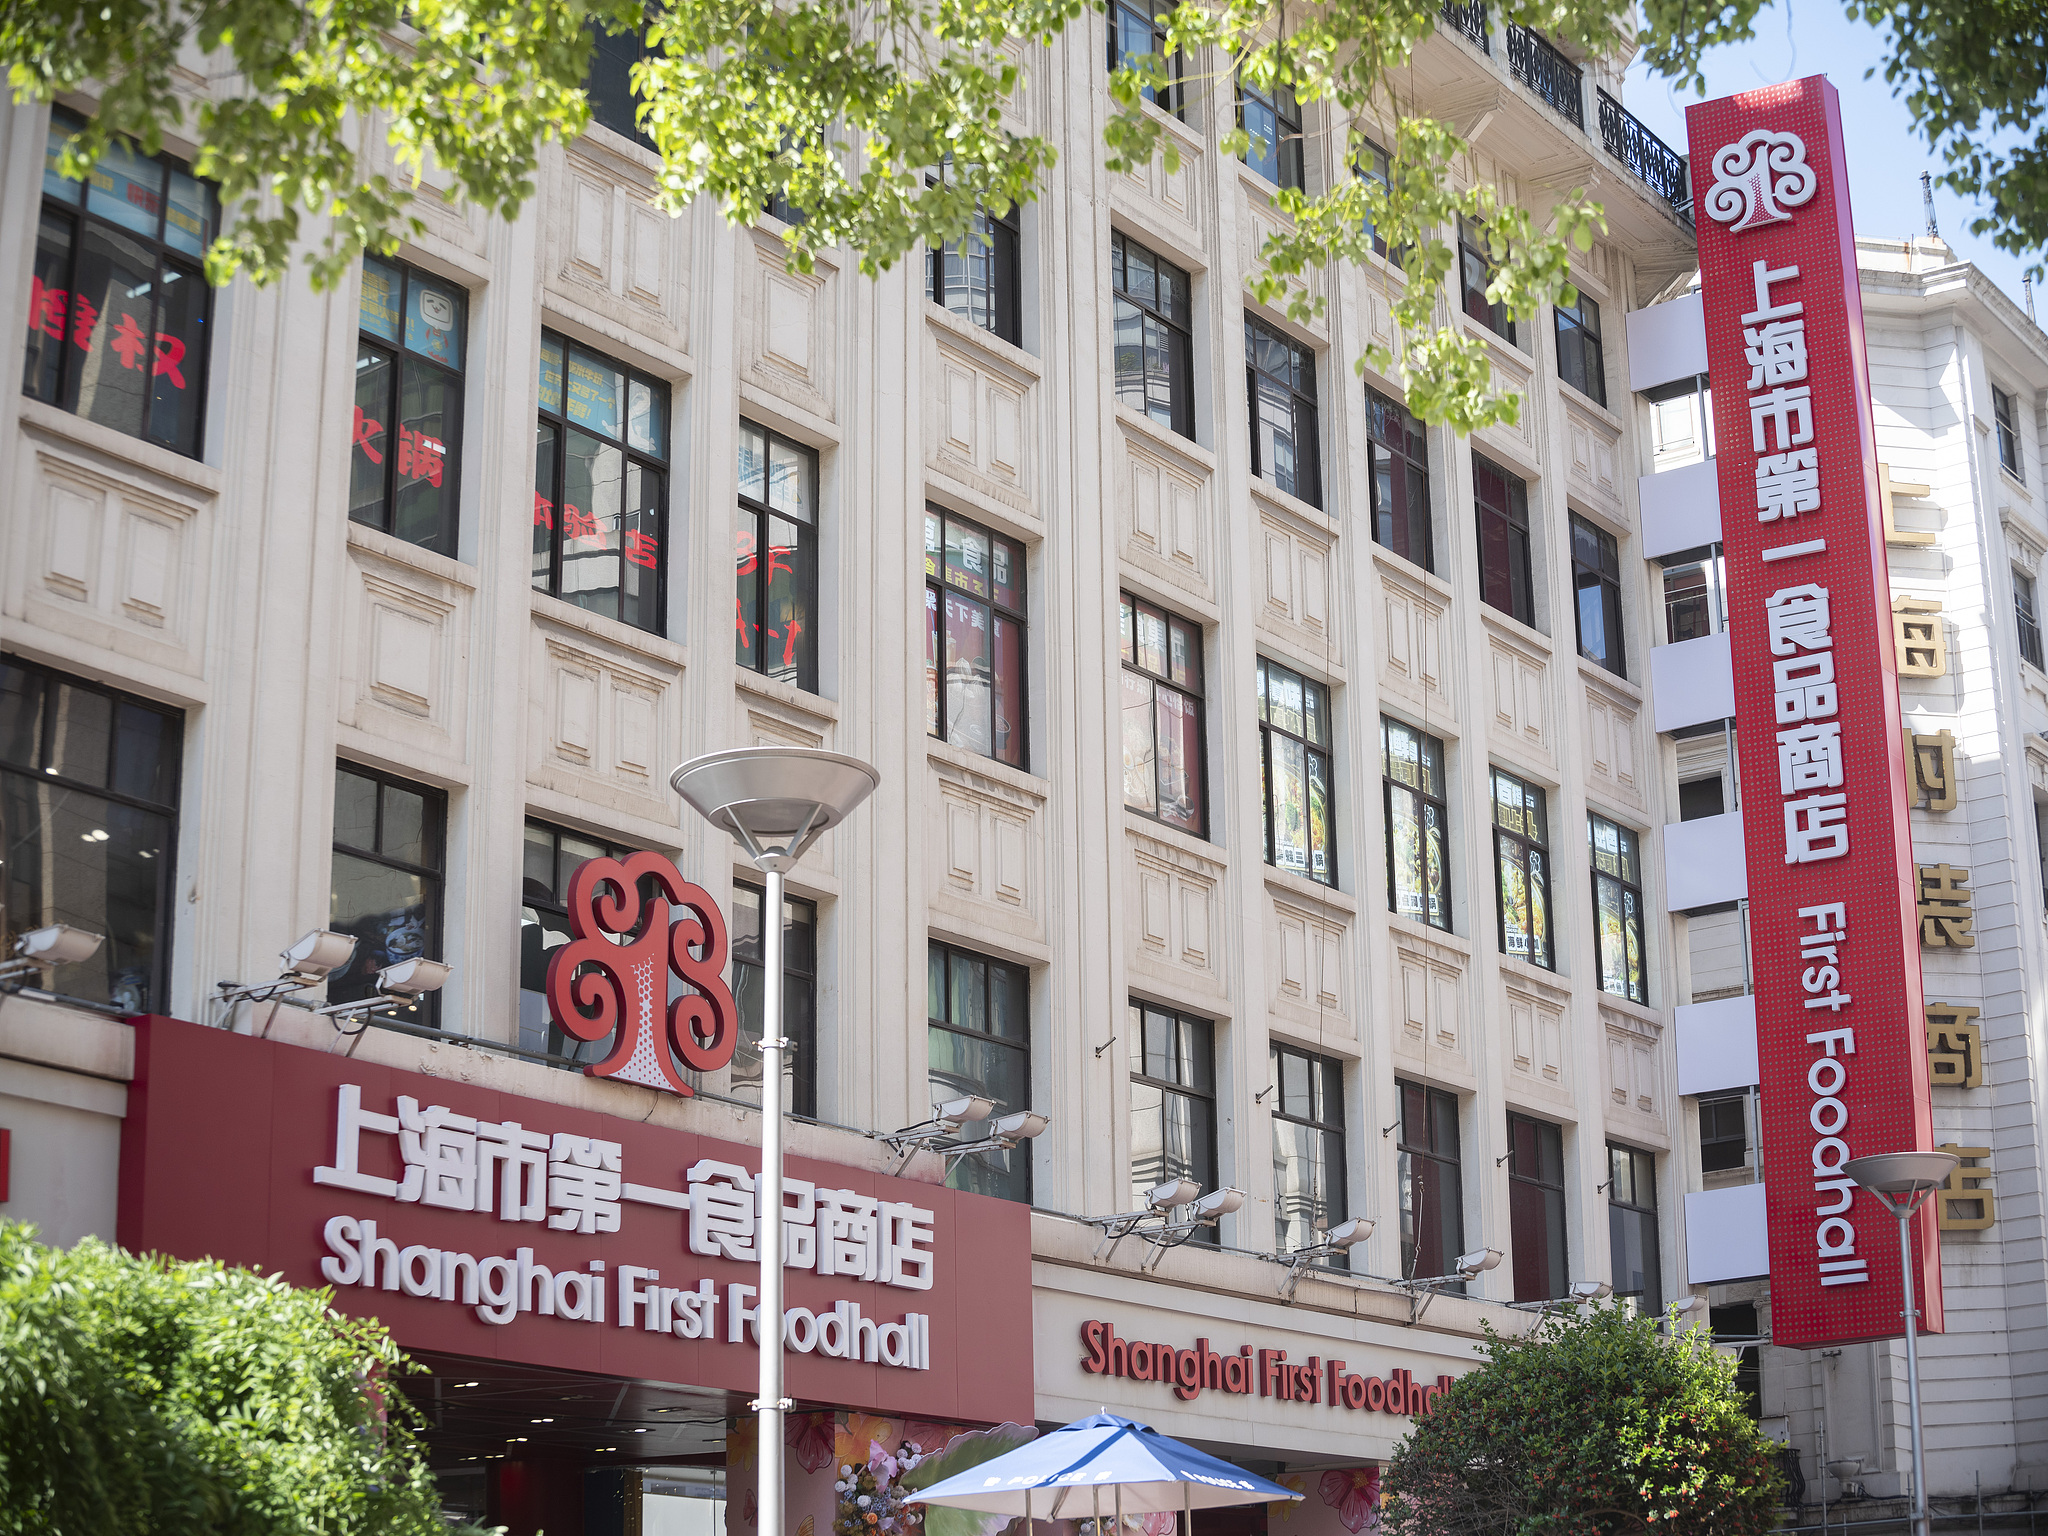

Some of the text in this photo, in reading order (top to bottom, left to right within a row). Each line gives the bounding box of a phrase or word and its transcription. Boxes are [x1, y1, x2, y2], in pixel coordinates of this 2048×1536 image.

[1740, 259, 1851, 865] 上海市第一食品商店
[312, 1083, 935, 1291] 上海市第一食品商店
[1797, 901, 1869, 1287] First Foodhall
[321, 1214, 930, 1371] Shanghai First Fodhall
[1080, 1319, 1455, 1416] Shanghai First Foodha
